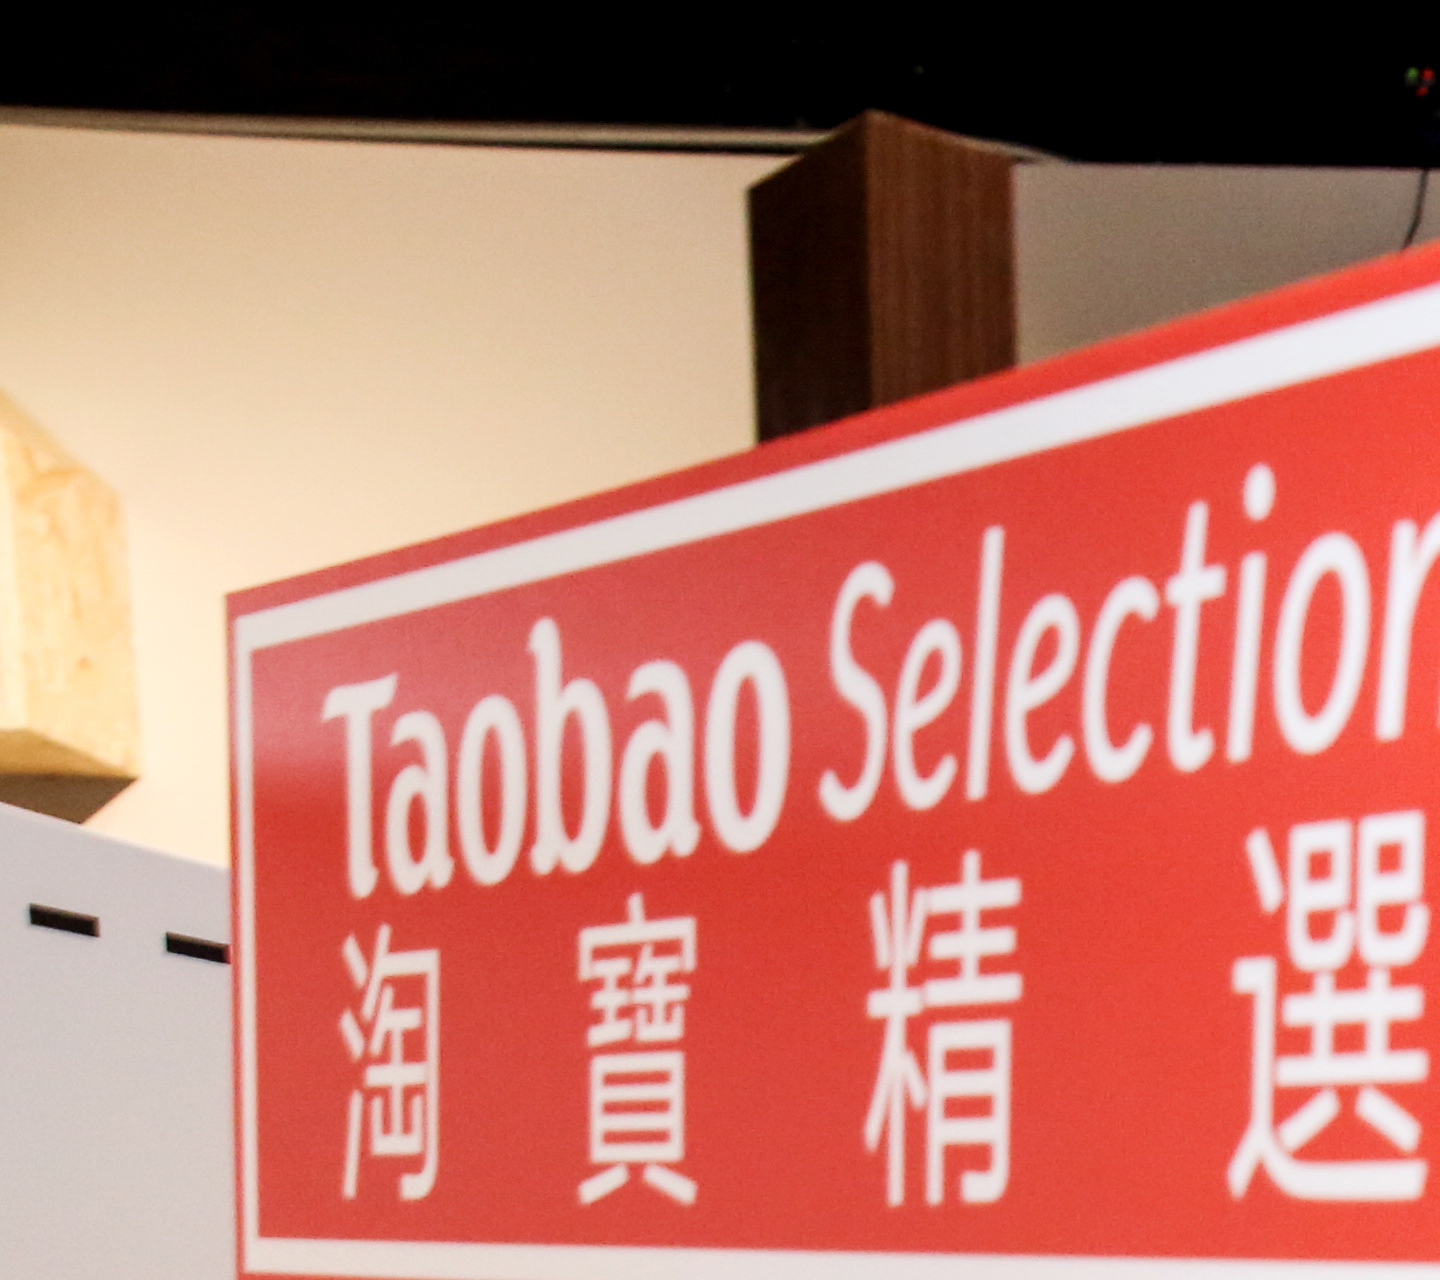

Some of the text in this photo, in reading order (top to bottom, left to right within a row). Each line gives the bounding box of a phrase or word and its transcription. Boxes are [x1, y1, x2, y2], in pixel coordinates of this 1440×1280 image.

[322, 617, 790, 899] Taobao
[339, 808, 1431, 1207] 淘寶精選
